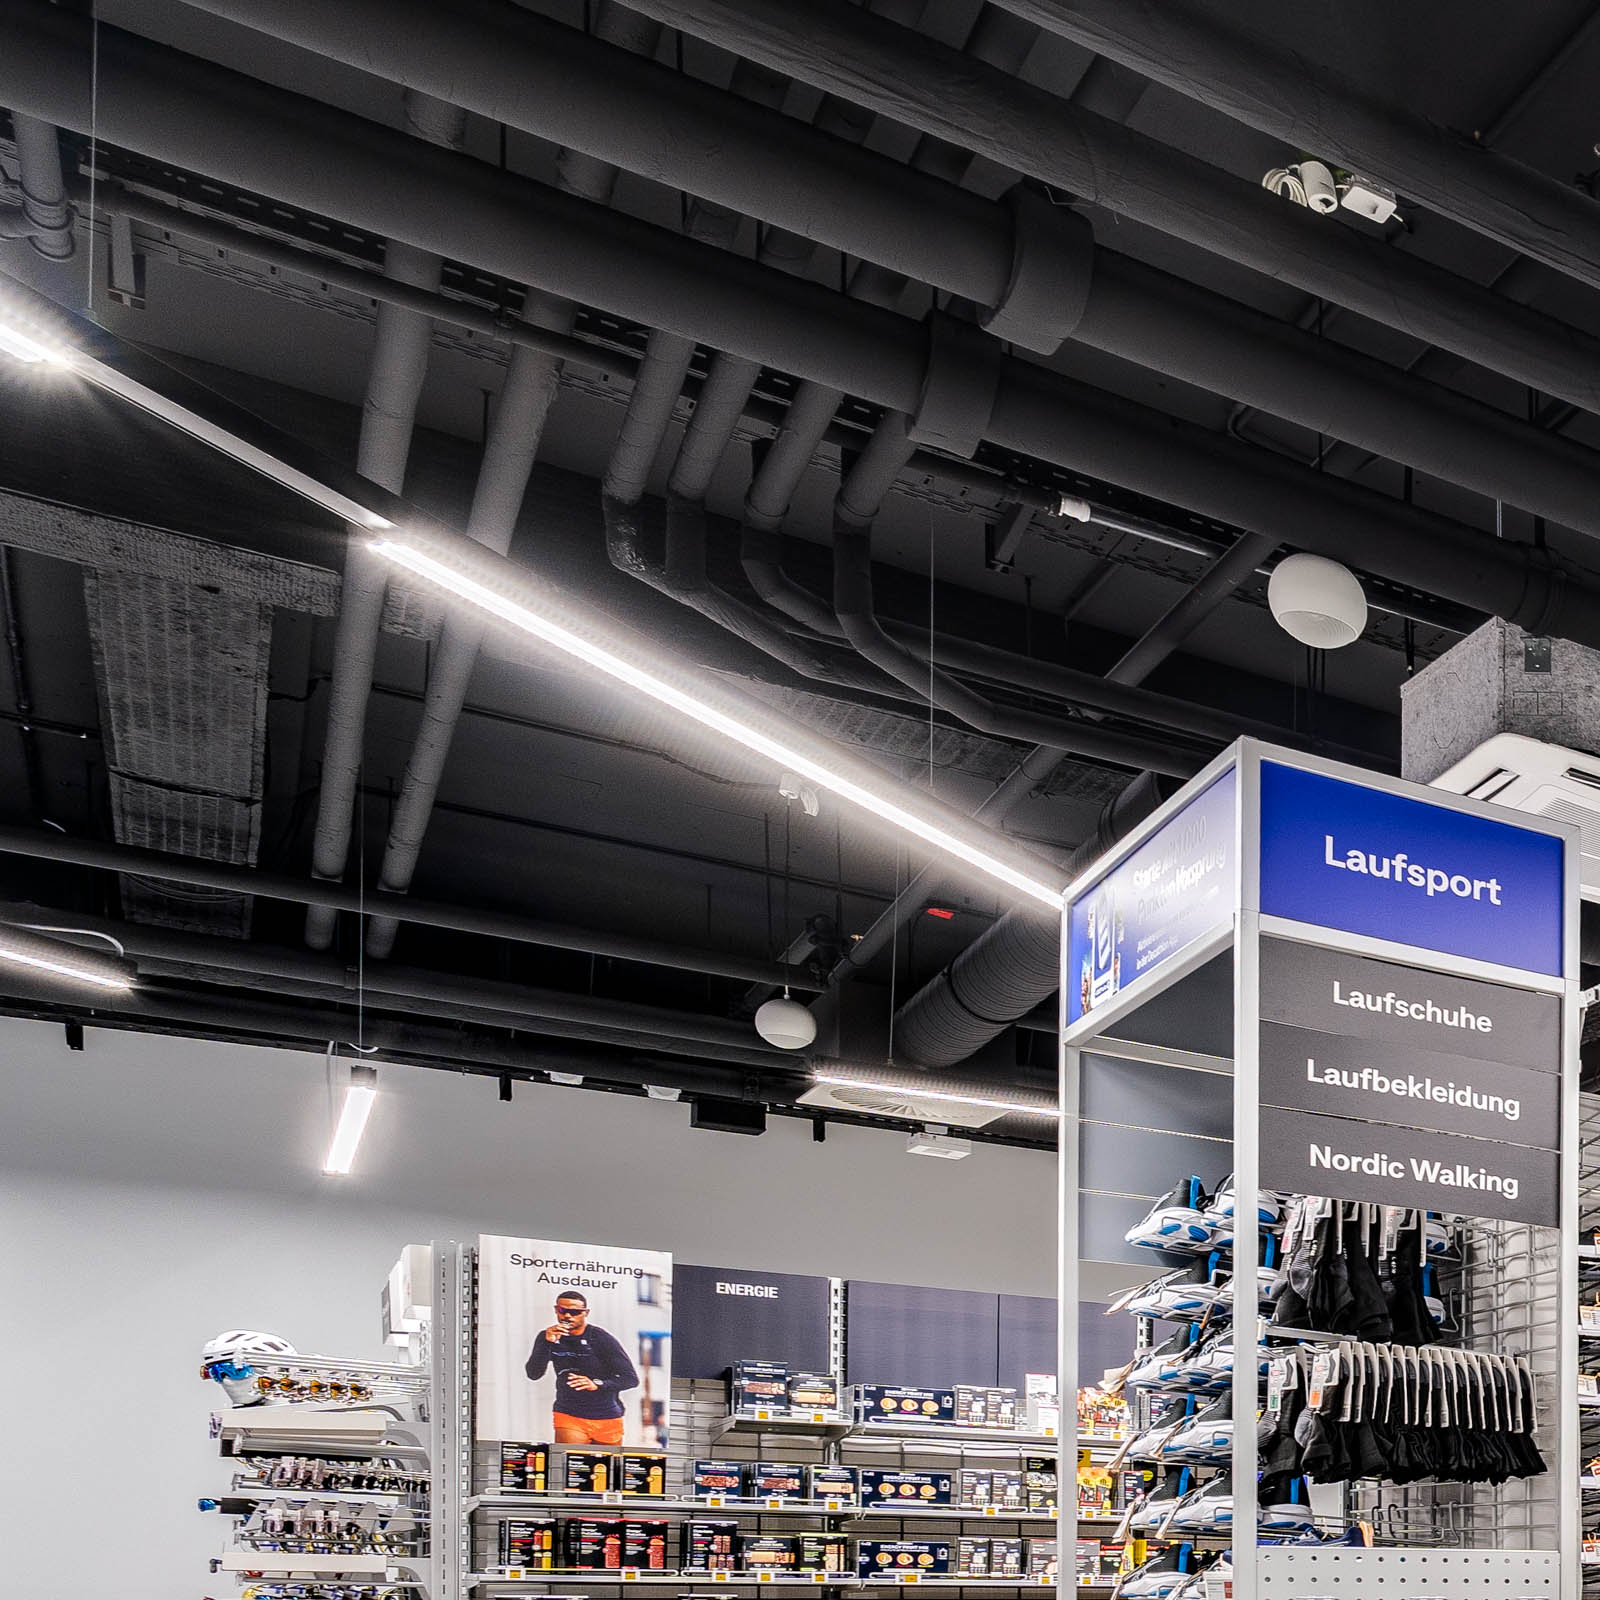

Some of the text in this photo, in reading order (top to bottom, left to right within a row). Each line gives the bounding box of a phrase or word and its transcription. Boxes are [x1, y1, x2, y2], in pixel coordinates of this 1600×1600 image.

[1325, 834, 1502, 906] Laufsport
[1333, 980, 1492, 1034] Laufschuhe
[1307, 1058, 1521, 1122] Laufbekleidung
[1309, 1143, 1519, 1200] Nordic Walking
[510, 1252, 644, 1279] Sporternährung
[537, 1272, 618, 1291] Ausdauer
[716, 1282, 779, 1299] ENERGIE
